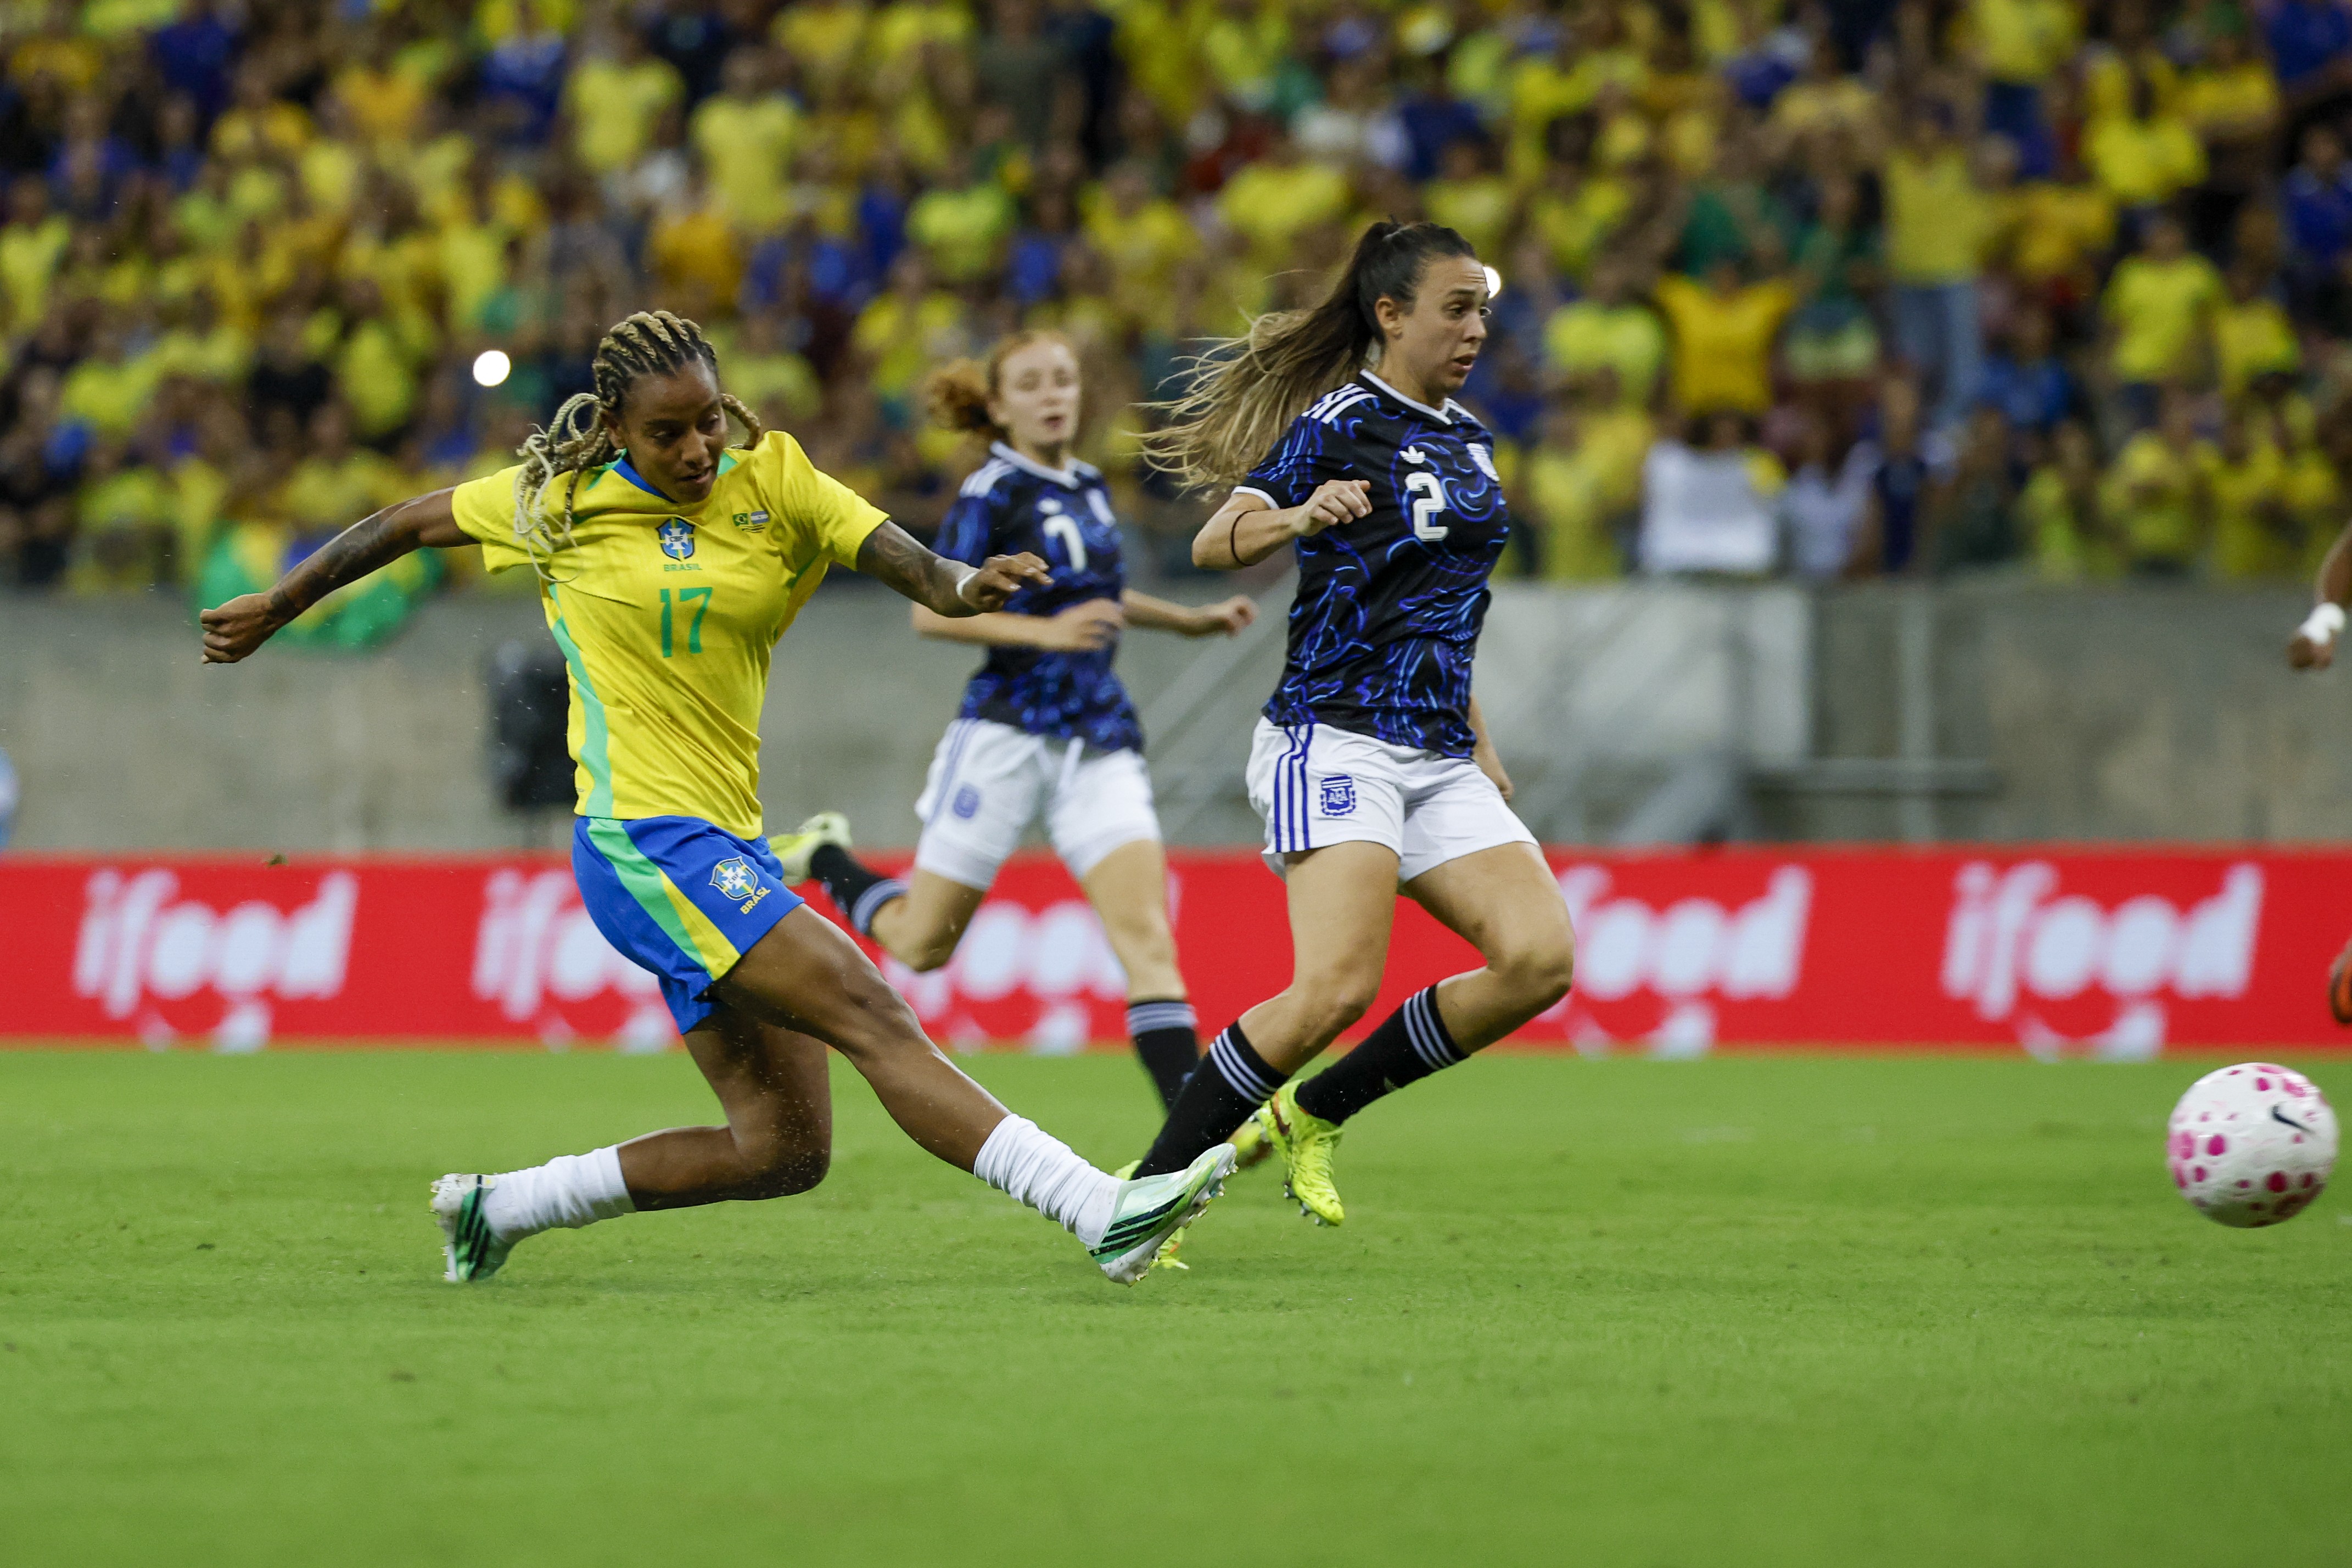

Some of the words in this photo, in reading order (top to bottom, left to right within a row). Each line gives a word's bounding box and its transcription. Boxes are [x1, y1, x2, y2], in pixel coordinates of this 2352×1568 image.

[1405, 472, 1448, 541] 2
[663, 563, 703, 572] BRASIL
[660, 587, 713, 658] 17
[728, 872, 739, 884] CBF
[74, 870, 356, 1017] ifood
[1941, 861, 2263, 1021] ifood
